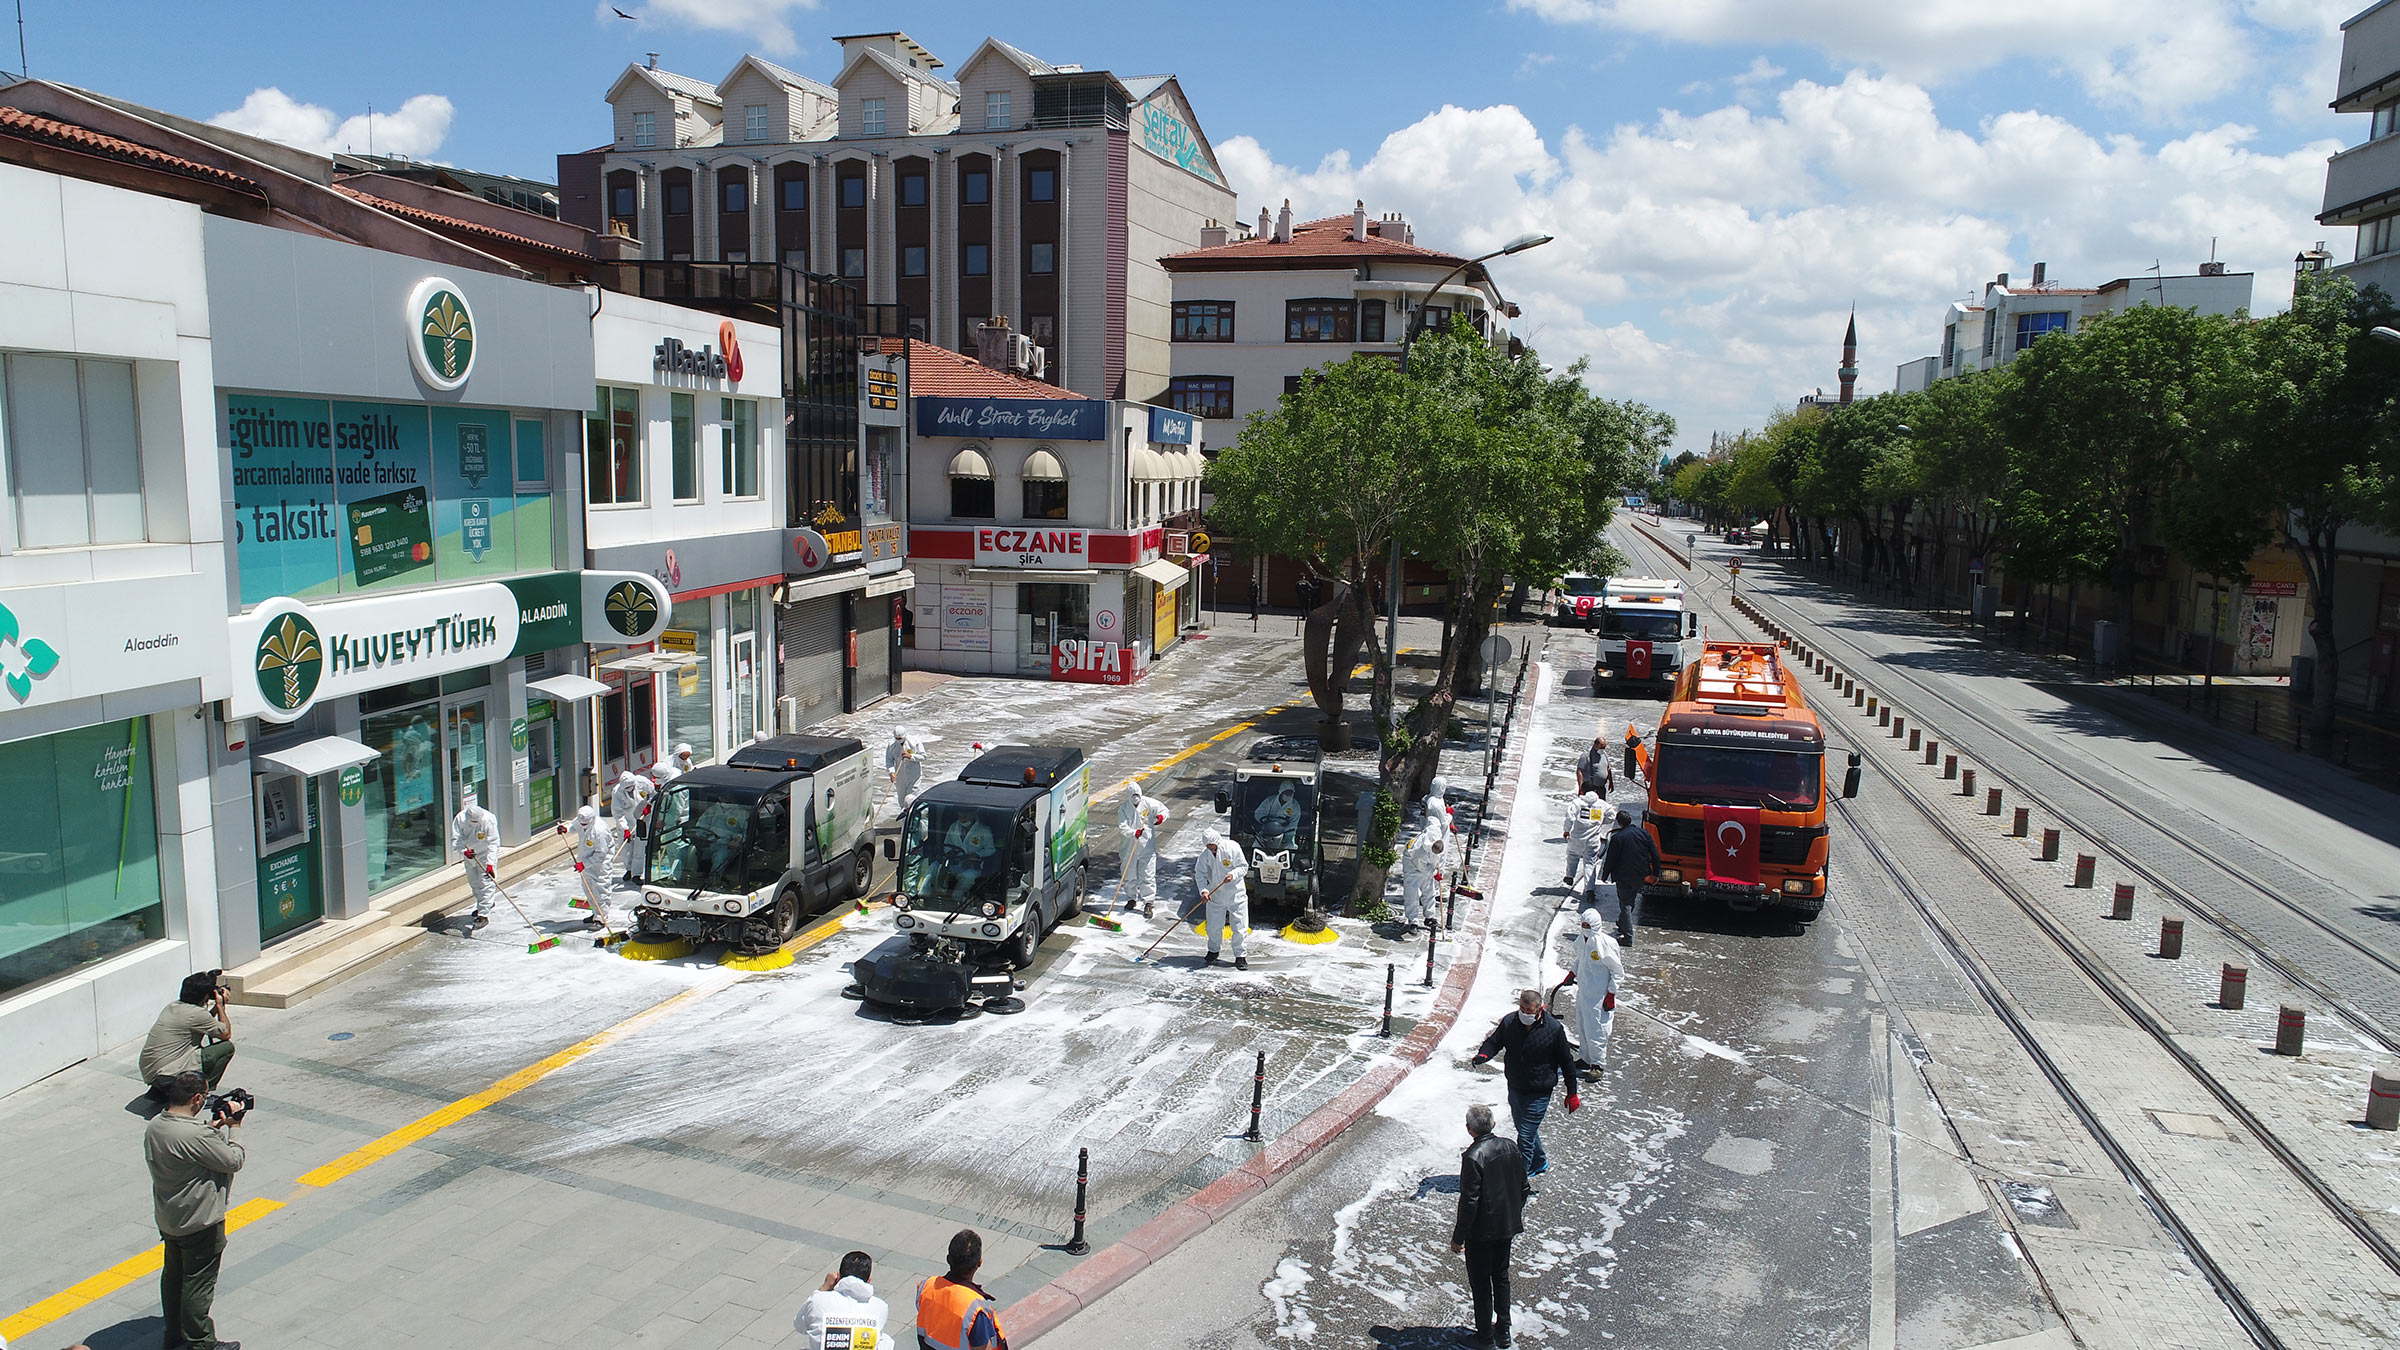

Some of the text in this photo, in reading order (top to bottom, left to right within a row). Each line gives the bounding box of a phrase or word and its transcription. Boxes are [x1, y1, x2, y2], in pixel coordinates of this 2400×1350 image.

[938, 406, 1079, 432] Wall Street English
[303, 420, 331, 449] ve
[336, 414, 400, 459] sağlık
[234, 460, 417, 486] arcamalarına vade farksız
[252, 498, 337, 543] taksit.
[979, 530, 1082, 554] ECZANE
[1019, 552, 1043, 566] ŞİFA
[520, 600, 568, 625] ALAADDİN
[949, 607, 983, 616] eczane
[124, 633, 179, 653] Alaaddin
[1102, 674, 1121, 682] 1969
[1722, 728, 1757, 738] BÜYÜKŞEHİR
[1758, 731, 1789, 740] BELEDİYESİ
[104, 743, 136, 762] Hayata
[94, 763, 129, 780] katılım
[269, 854, 299, 871] EXCHANGE
[827, 1333, 850, 1341] BENİM
